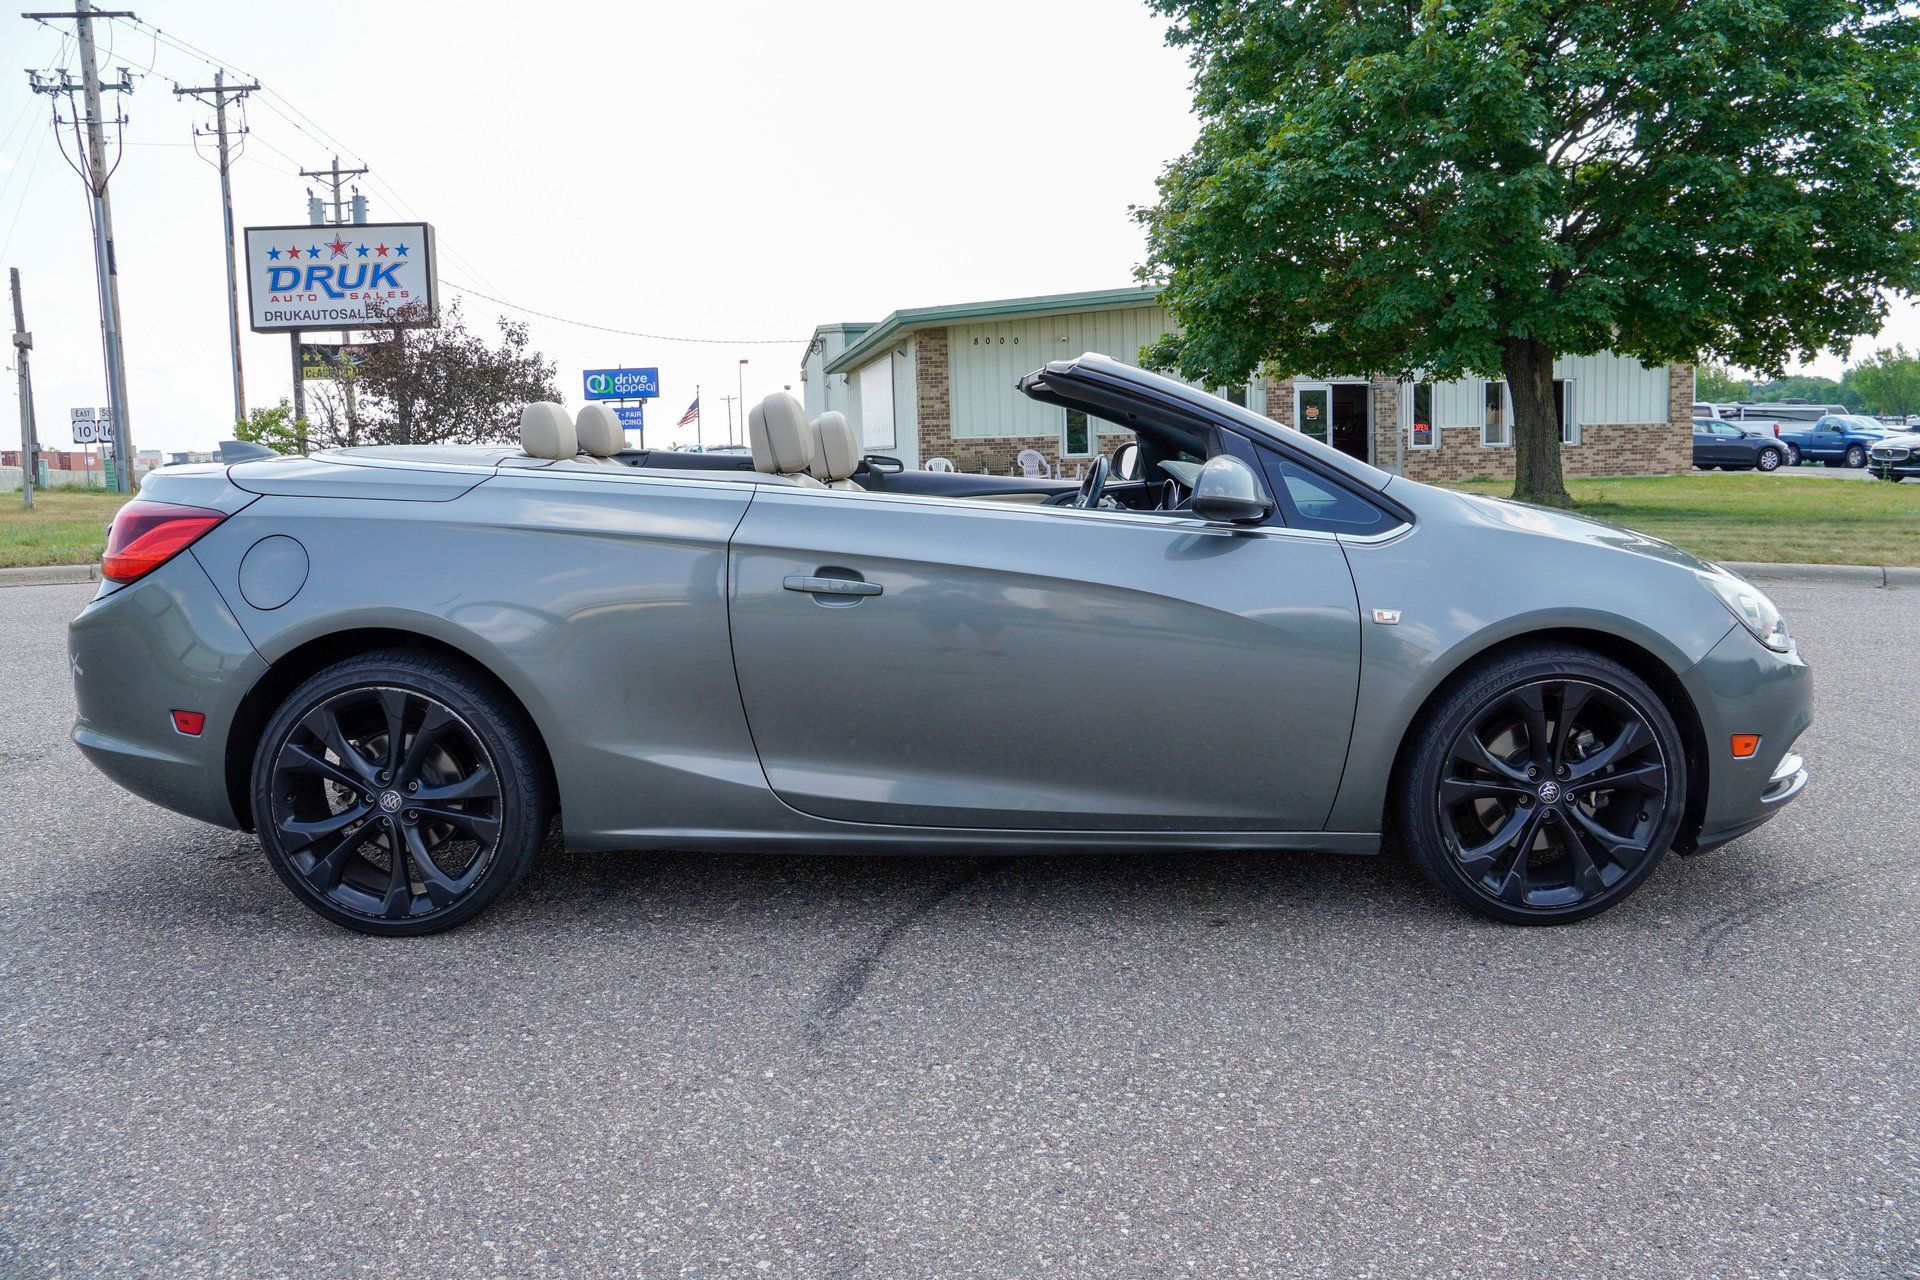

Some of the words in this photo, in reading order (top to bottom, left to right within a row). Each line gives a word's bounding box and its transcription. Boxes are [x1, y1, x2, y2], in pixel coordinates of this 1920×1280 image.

[266, 261, 408, 301] DRUK
[270, 294, 318, 303] AUTO
[350, 290, 409, 300] SALES
[264, 307, 418, 322] DRUKAUTOSALES.C
[973, 337, 1019, 345] 8000
[614, 373, 648, 384] drive
[615, 382, 656, 394] appeal
[75, 409, 90, 418] EAST
[78, 426, 91, 438] 10
